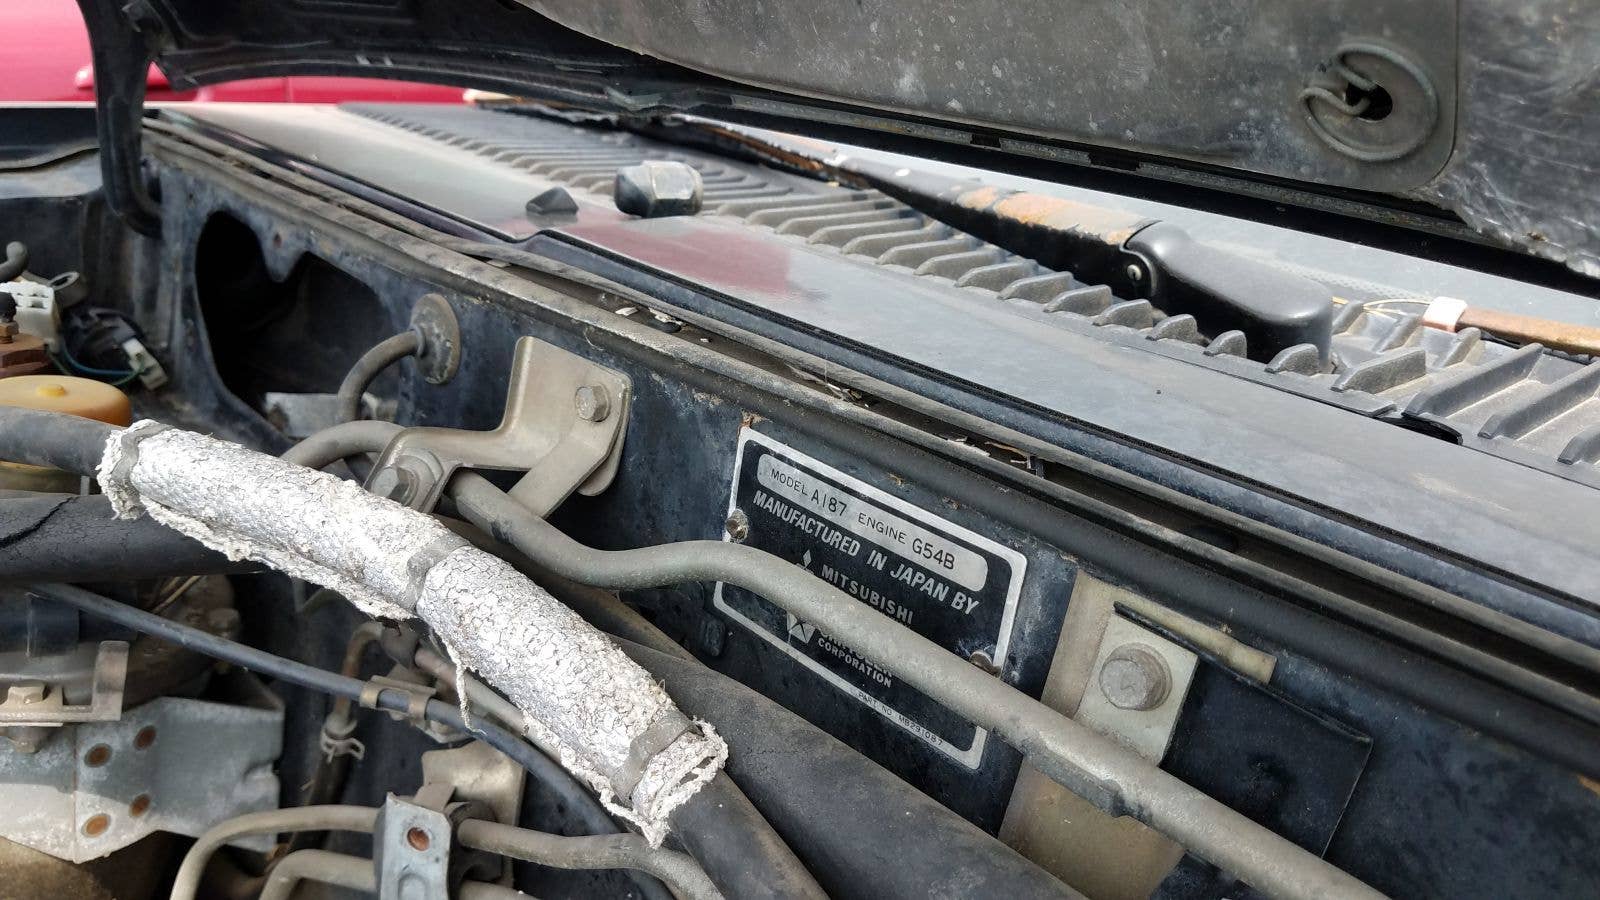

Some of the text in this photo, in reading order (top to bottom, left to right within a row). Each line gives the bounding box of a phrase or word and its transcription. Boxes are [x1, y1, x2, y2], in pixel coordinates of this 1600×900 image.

[771, 469, 808, 496] MODEL
[858, 513, 907, 544] ENGINE
[912, 538, 955, 570] G54B
[753, 490, 979, 615] MANUFACTURED IN JAPAN BY
[821, 565, 913, 624] MITSUBISHI
[817, 637, 892, 688] CORPORATION
[858, 692, 878, 708] PART
